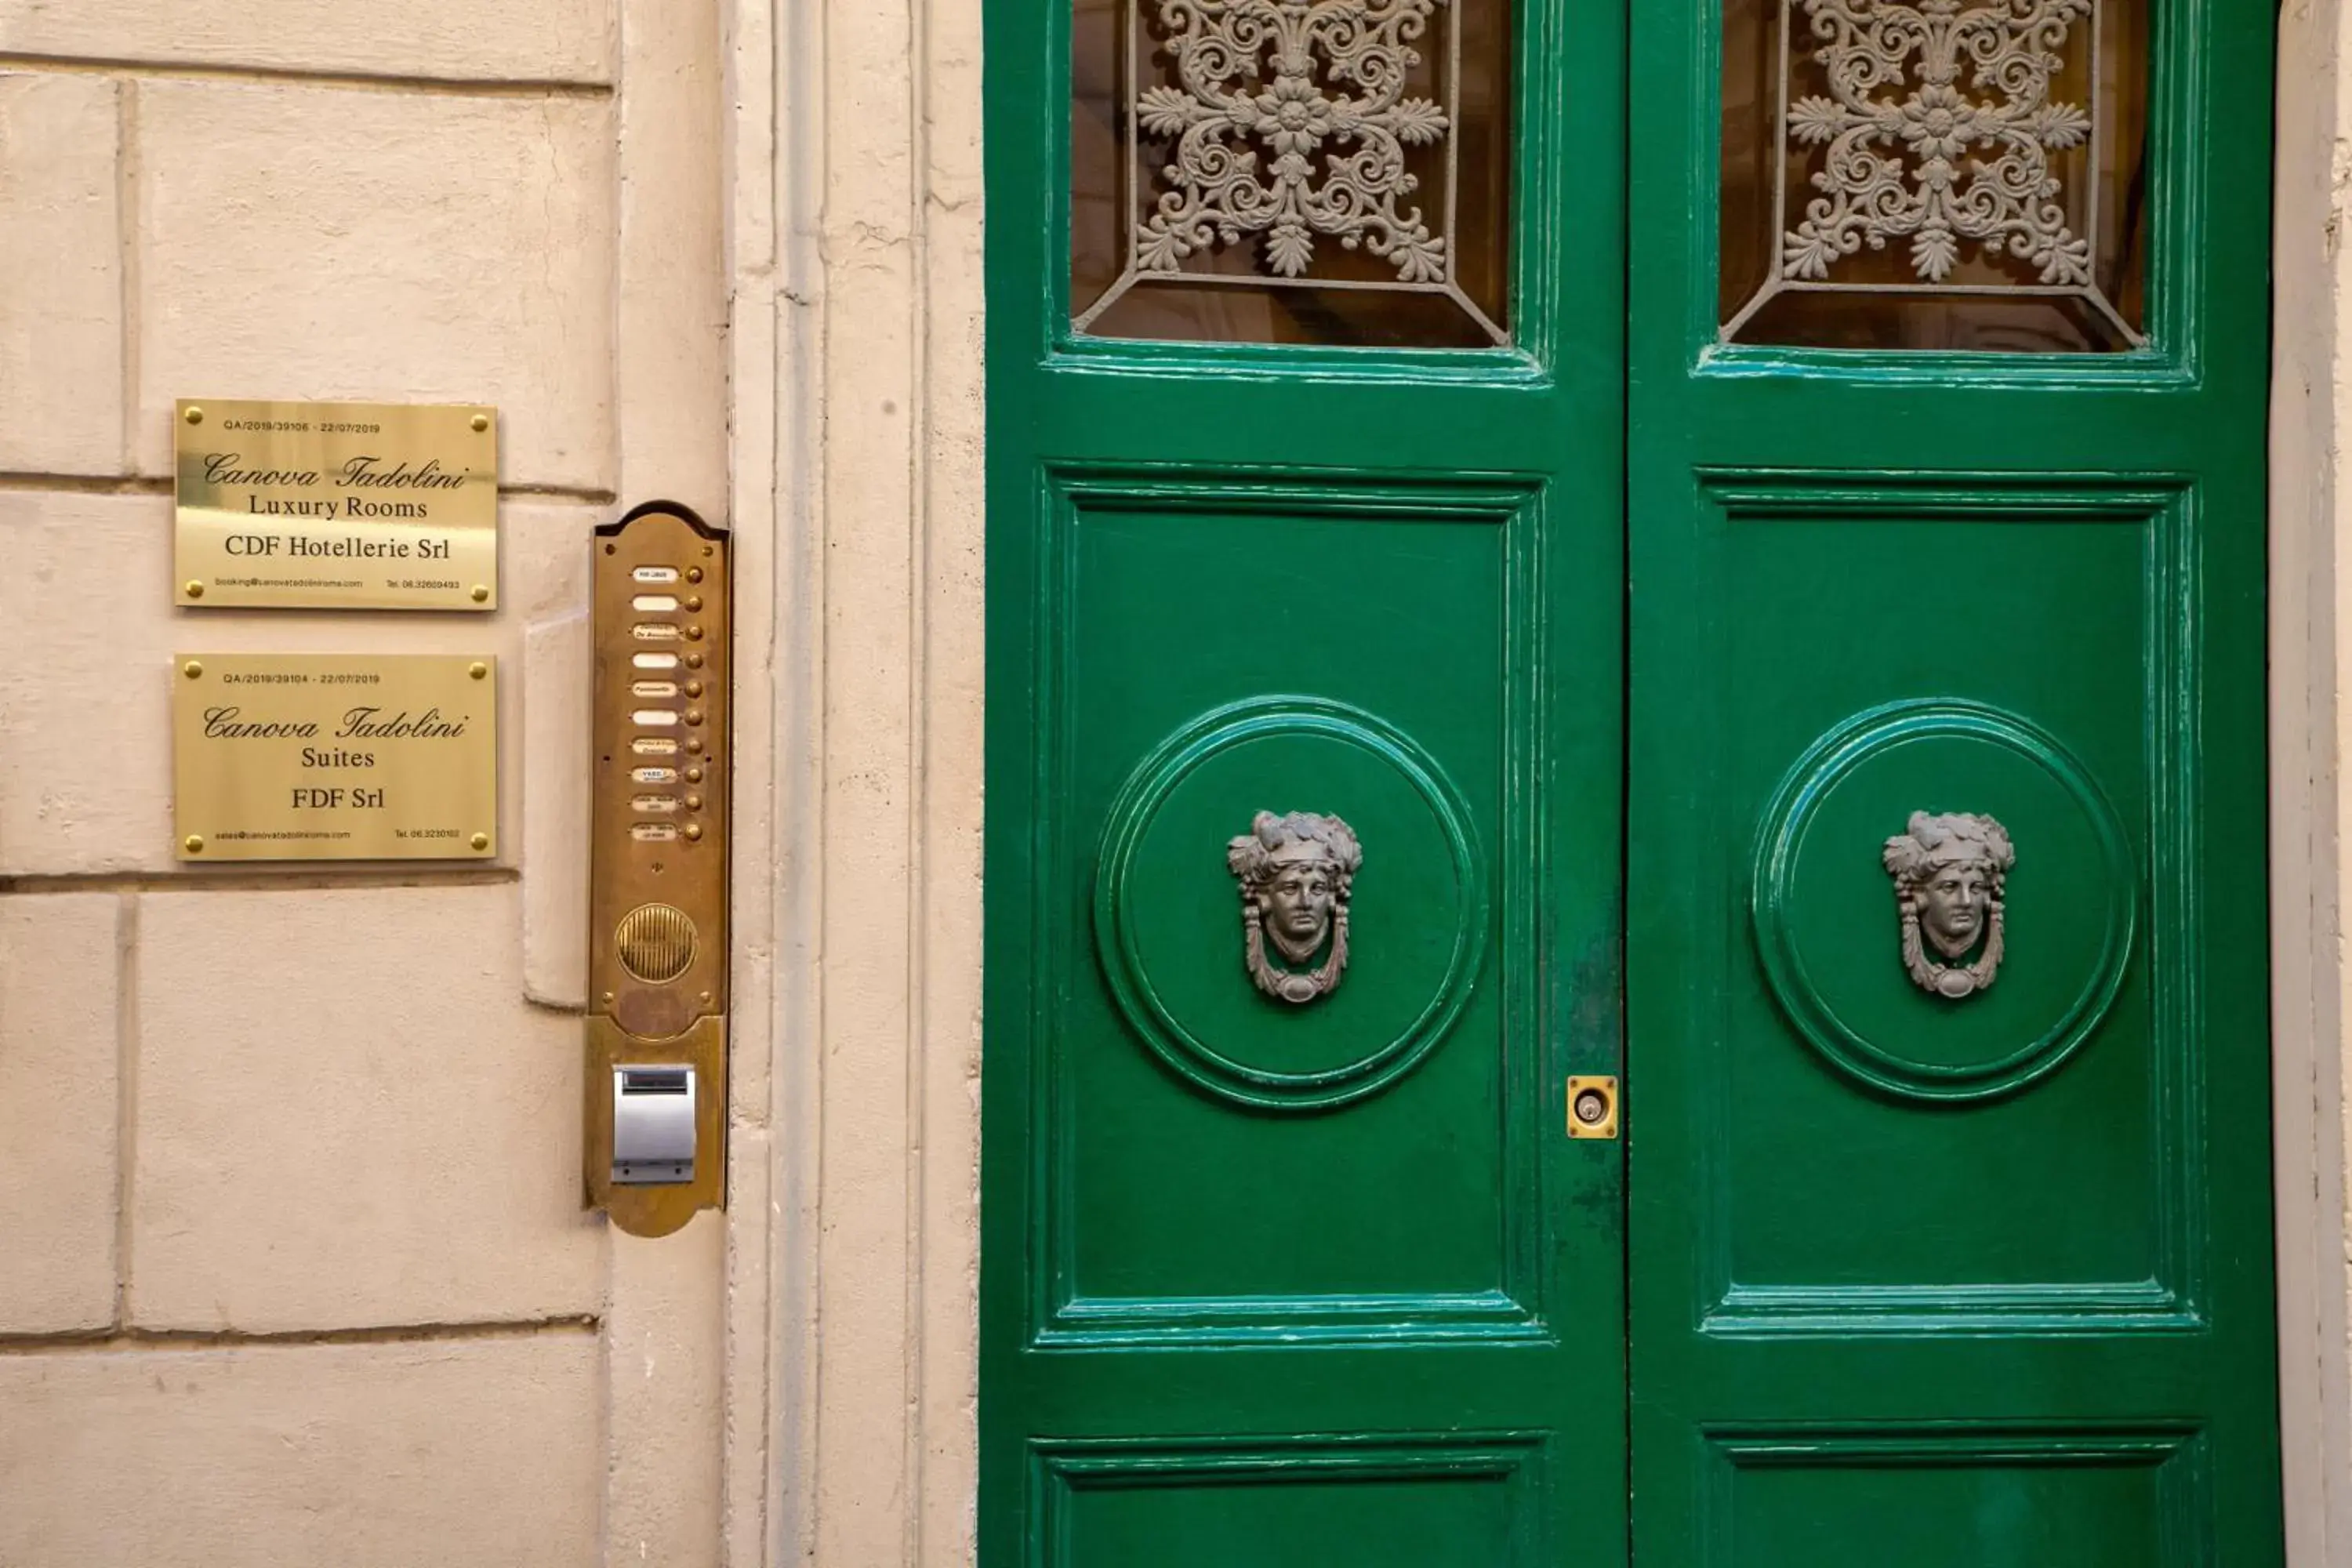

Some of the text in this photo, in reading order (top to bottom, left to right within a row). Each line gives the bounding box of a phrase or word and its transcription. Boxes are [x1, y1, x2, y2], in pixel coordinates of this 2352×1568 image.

[223, 419, 309, 431] QA/2019/39106
[320, 423, 380, 434] 22/07/2019
[204, 452, 470, 489] Canova Tadolini
[249, 495, 427, 520] Luxury Rooms
[225, 536, 450, 559] CDF Hotellerie Srl
[223, 673, 308, 684] QA/2019/39104
[320, 673, 380, 684] 22/07/2019
[203, 706, 470, 739] Canova Tadolini
[302, 747, 374, 768] Suites
[292, 788, 385, 808] FDF Srl
